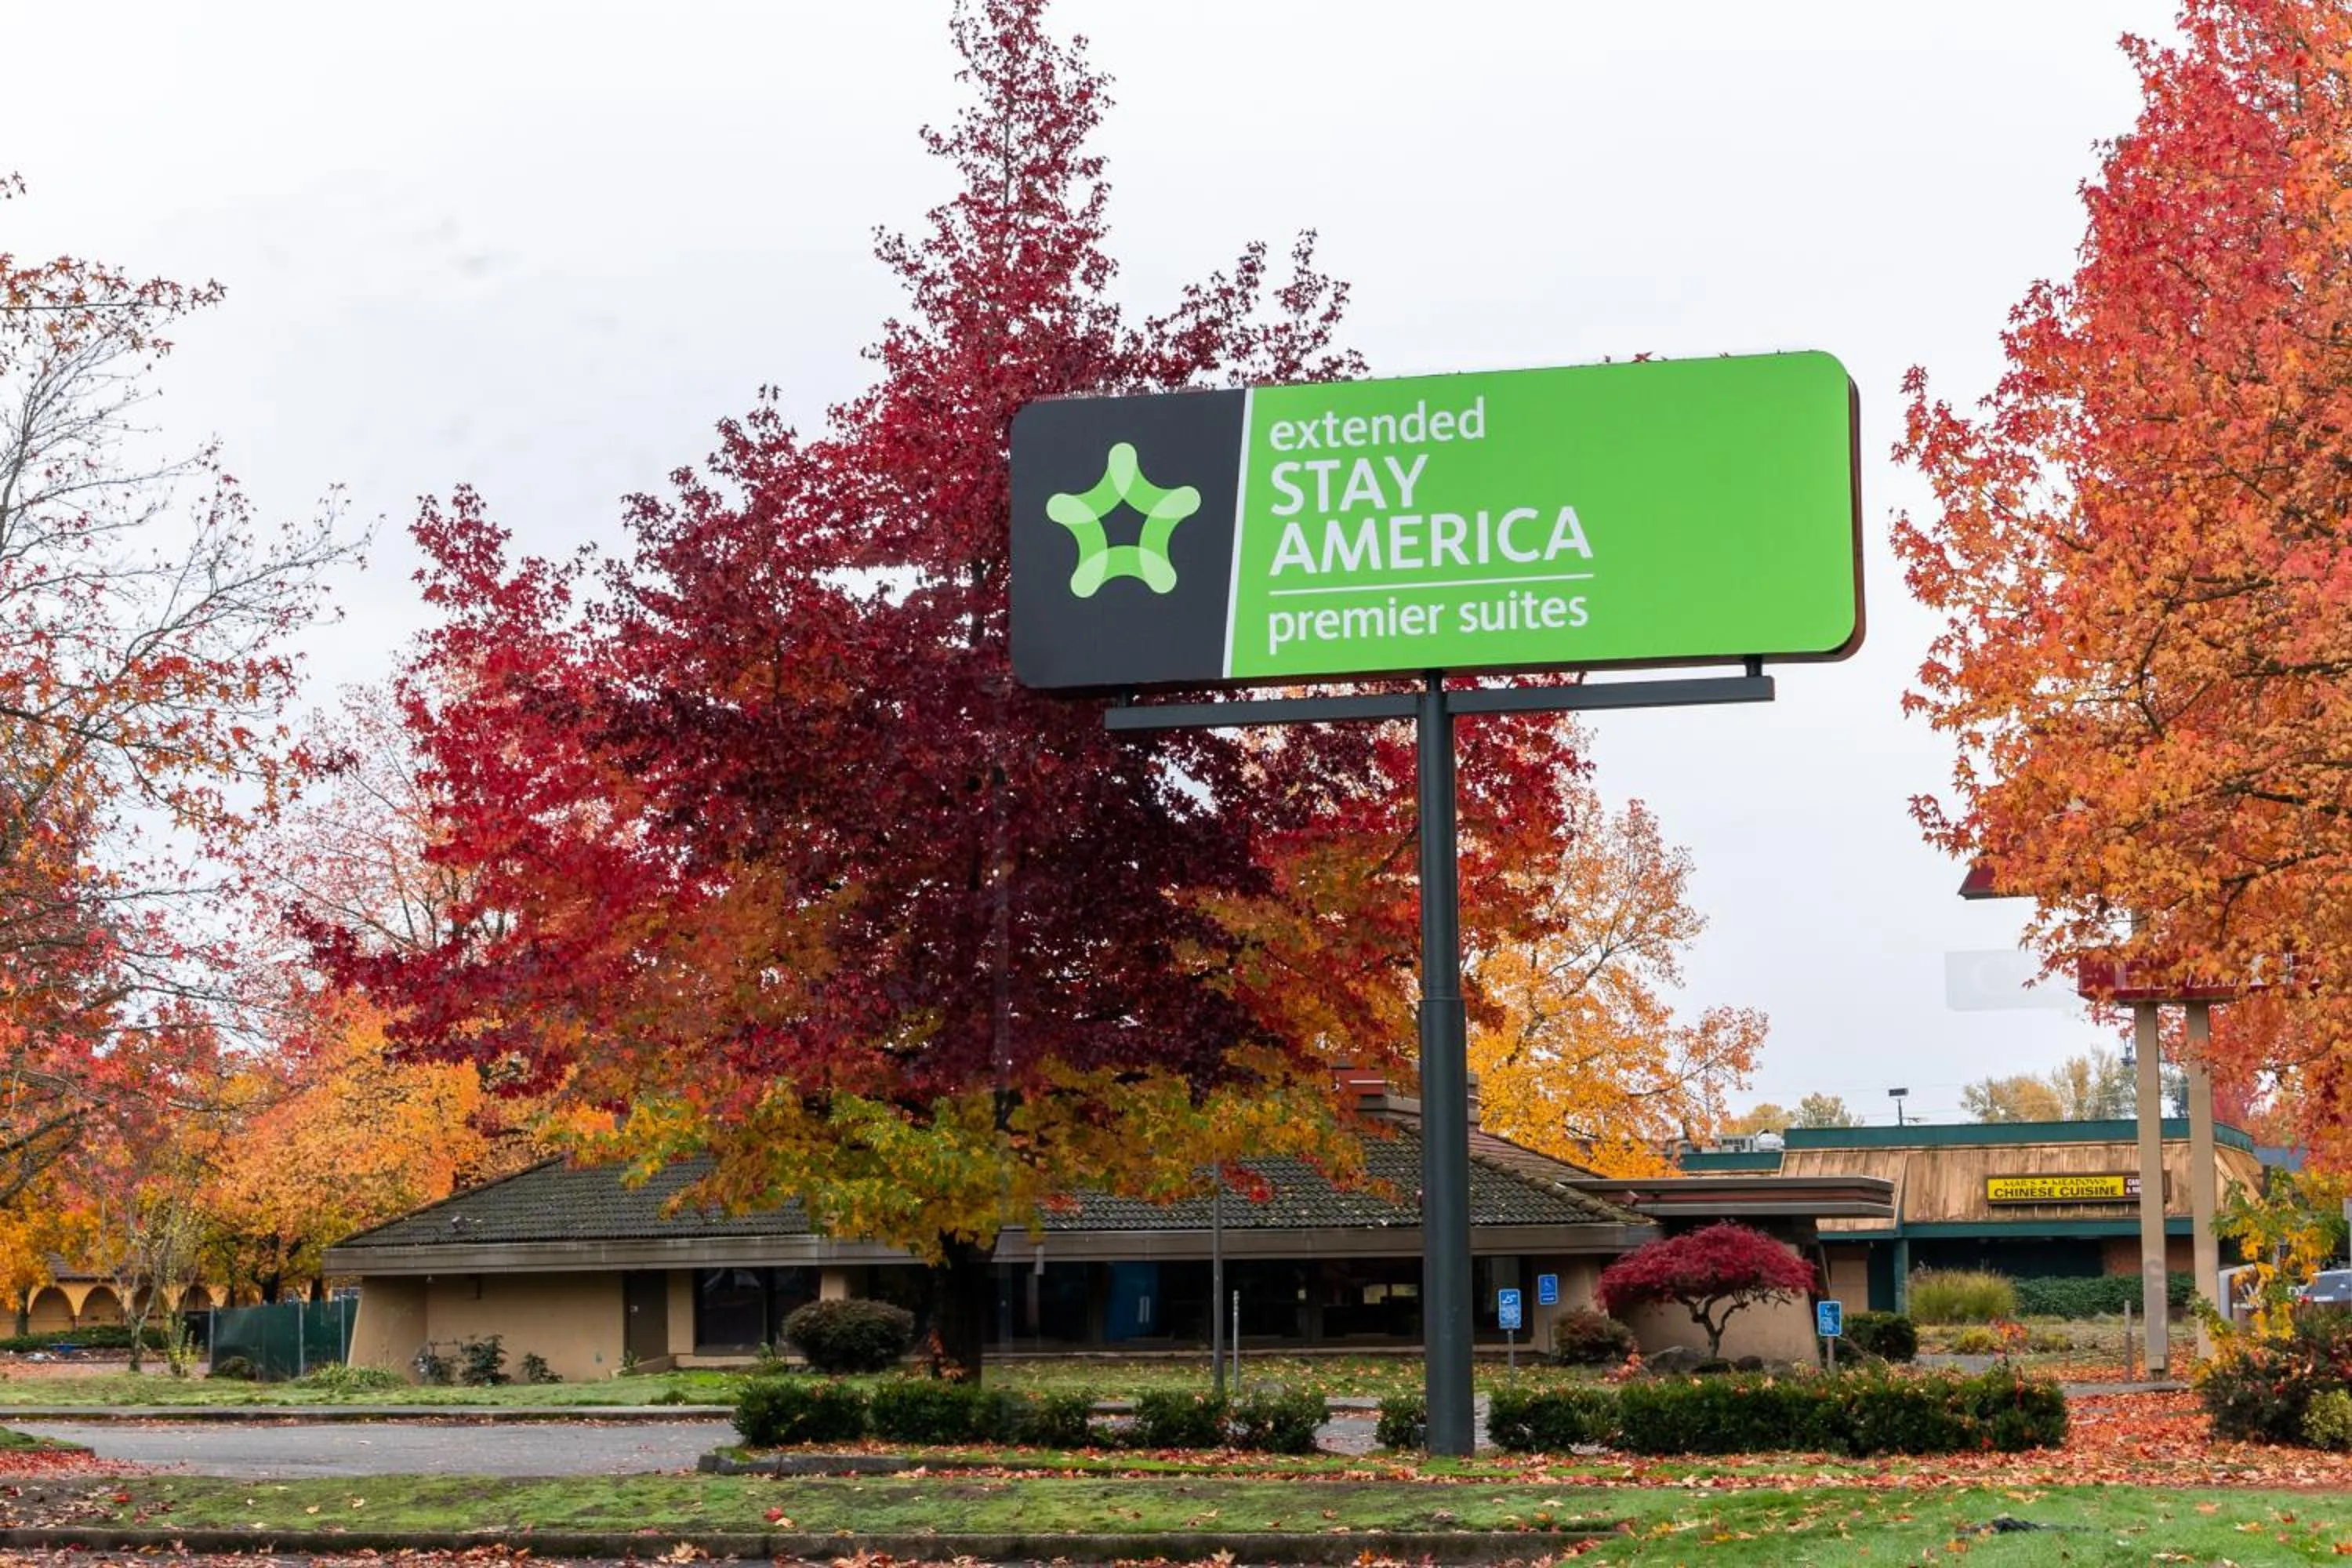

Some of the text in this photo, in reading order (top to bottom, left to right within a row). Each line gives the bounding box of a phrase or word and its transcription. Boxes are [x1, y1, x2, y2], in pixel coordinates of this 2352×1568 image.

[1269, 395, 1486, 452] extended
[1270, 453, 1429, 516] STAY
[1269, 506, 1595, 578] AMERICA
[1268, 590, 1589, 655] premier suites
[1994, 1186, 2055, 1197] CHINESE
[2060, 1185, 2118, 1196] CUISINE
